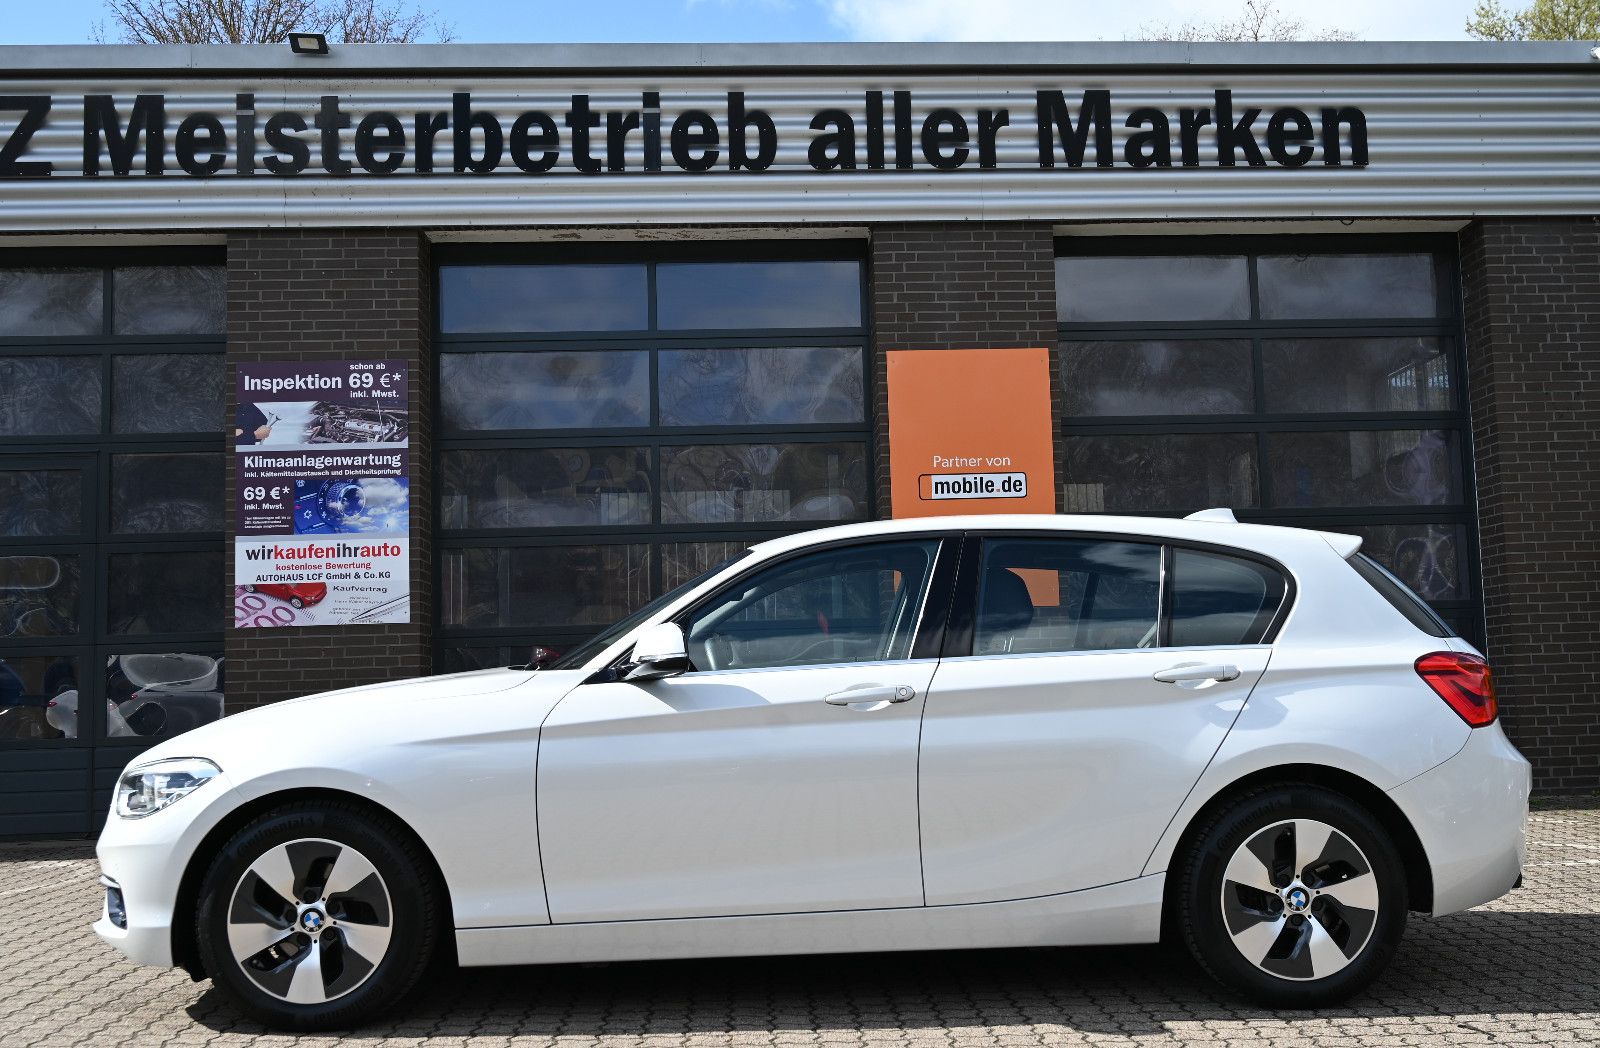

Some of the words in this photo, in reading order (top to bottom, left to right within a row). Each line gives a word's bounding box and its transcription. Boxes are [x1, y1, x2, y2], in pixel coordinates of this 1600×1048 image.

[83, 91, 777, 176] Meisterbetrieb
[807, 90, 1008, 170] aller
[1036, 89, 1369, 168] Marken
[244, 374, 342, 393] Inspektion
[349, 373, 373, 388] 69
[350, 390, 369, 398] inkl.
[372, 390, 399, 398] Mwst.
[244, 454, 401, 469] Klimaanlagenwartung
[933, 455, 982, 468] Partner
[986, 456, 1011, 467] von
[934, 475, 1023, 495] mobile.de
[243, 487, 266, 500] 69
[262, 502, 285, 510] Mwst.
[246, 543, 401, 560] wirkaufenihrauto
[276, 562, 323, 571] kostenlose
[326, 562, 372, 571] Bewertung
[256, 573, 304, 582] AUTOHAUS
[307, 573, 323, 581] LCF
[326, 572, 351, 580] GmbH
[353, 572, 361, 580] &
[333, 585, 388, 594] Kaufvertrag
